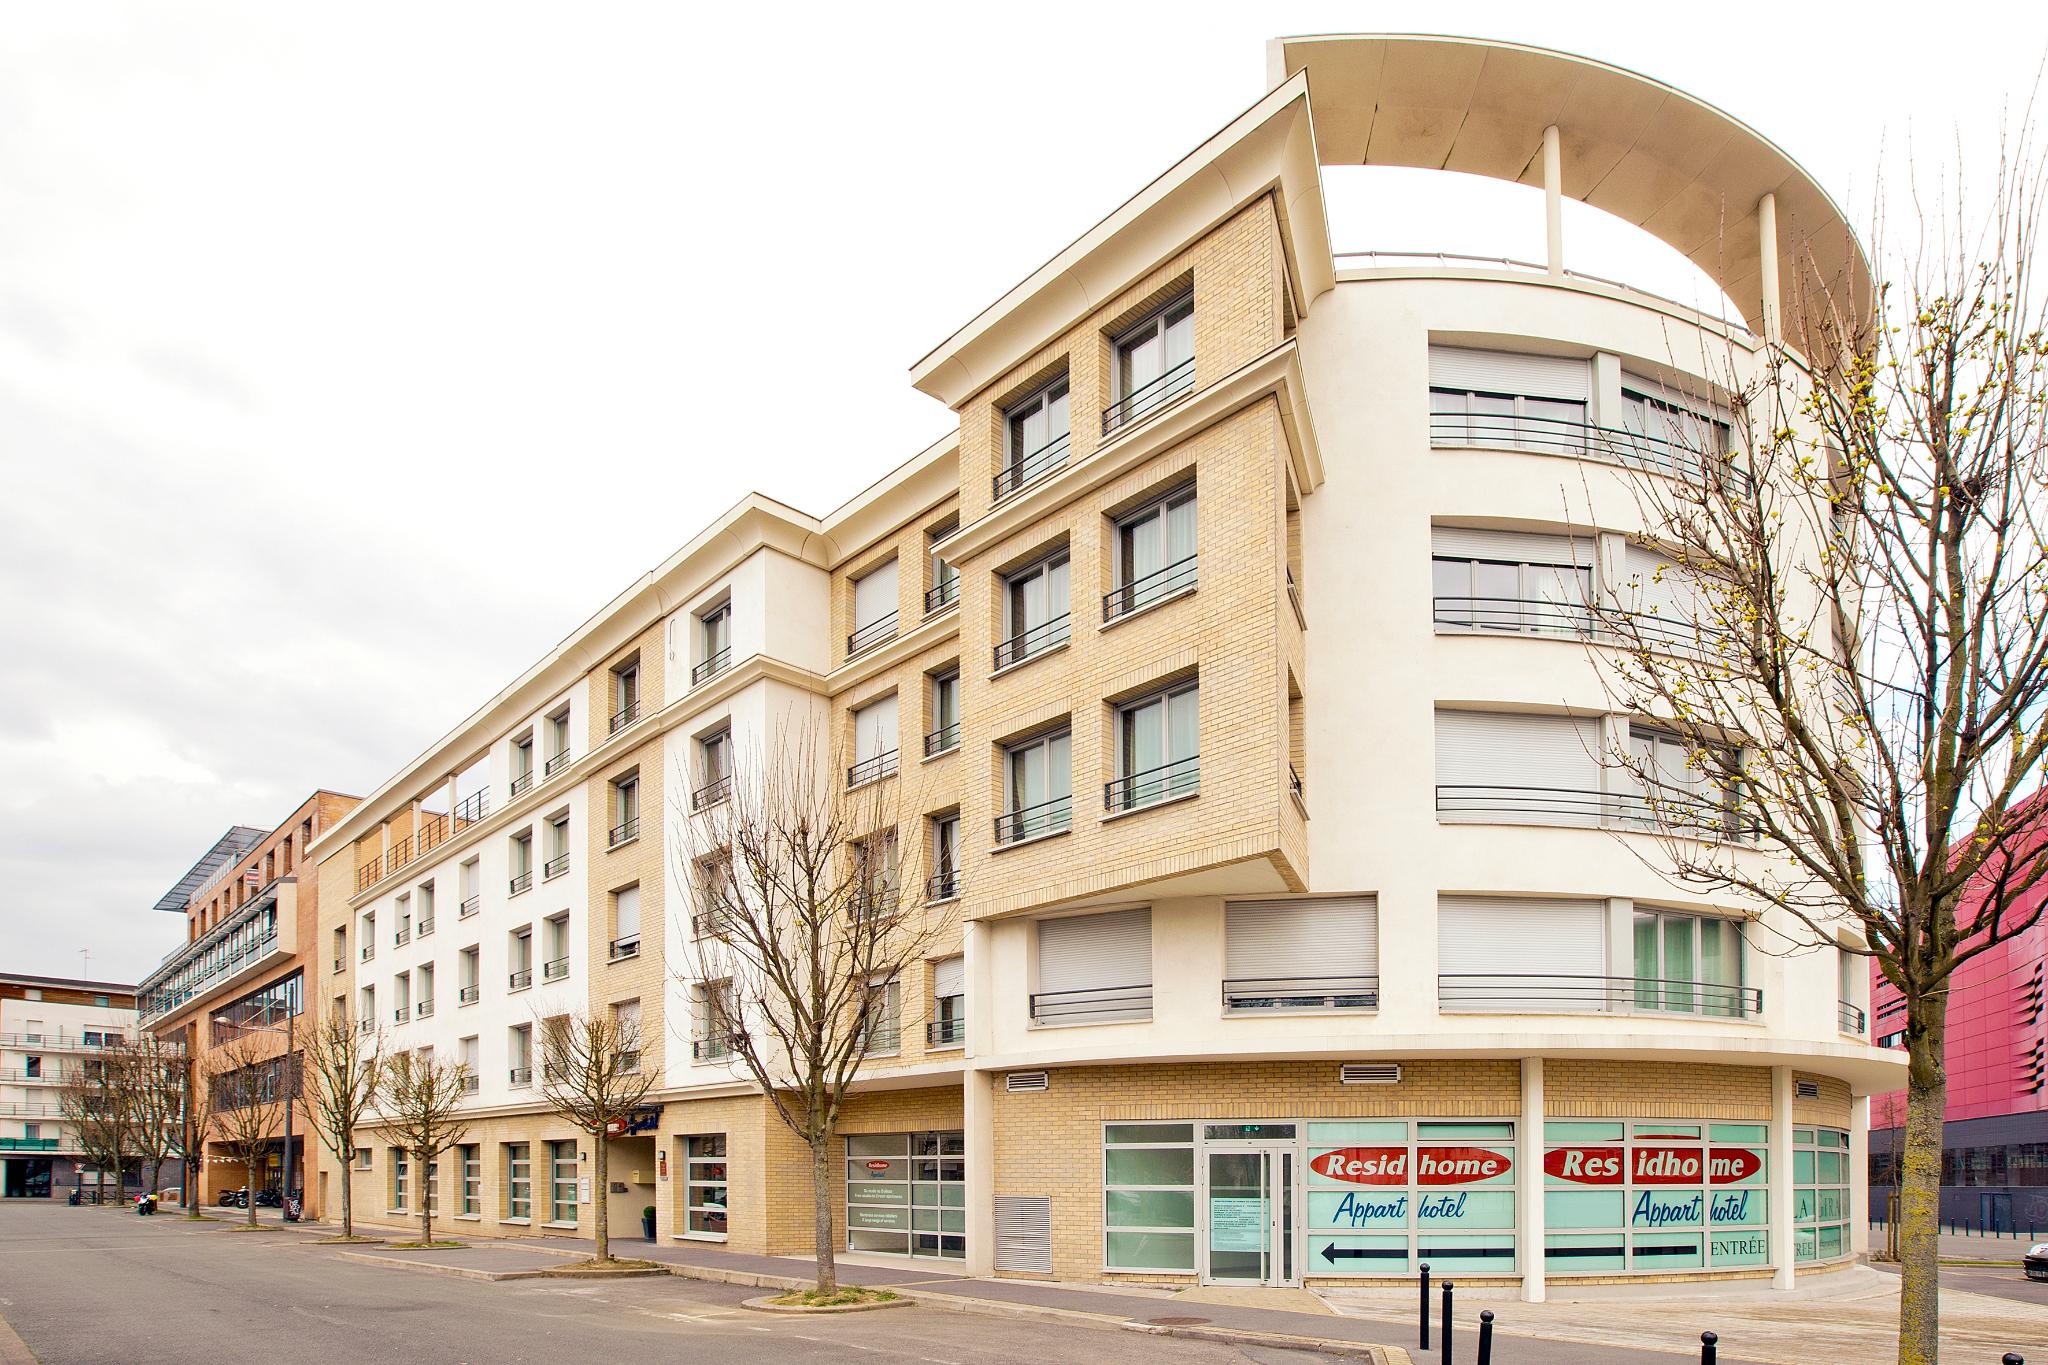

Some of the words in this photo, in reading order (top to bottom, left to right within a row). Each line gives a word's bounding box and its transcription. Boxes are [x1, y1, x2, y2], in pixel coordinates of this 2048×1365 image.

[1332, 1191, 1408, 1228] Appart
[1417, 1191, 1468, 1219] hotel
[1632, 1190, 1703, 1228] Appart
[1710, 1189, 1749, 1221] hotel
[1793, 1198, 1808, 1219] A
[1711, 1236, 1766, 1256] ENTRÉE
[1793, 1239, 1814, 1257] RÉE
